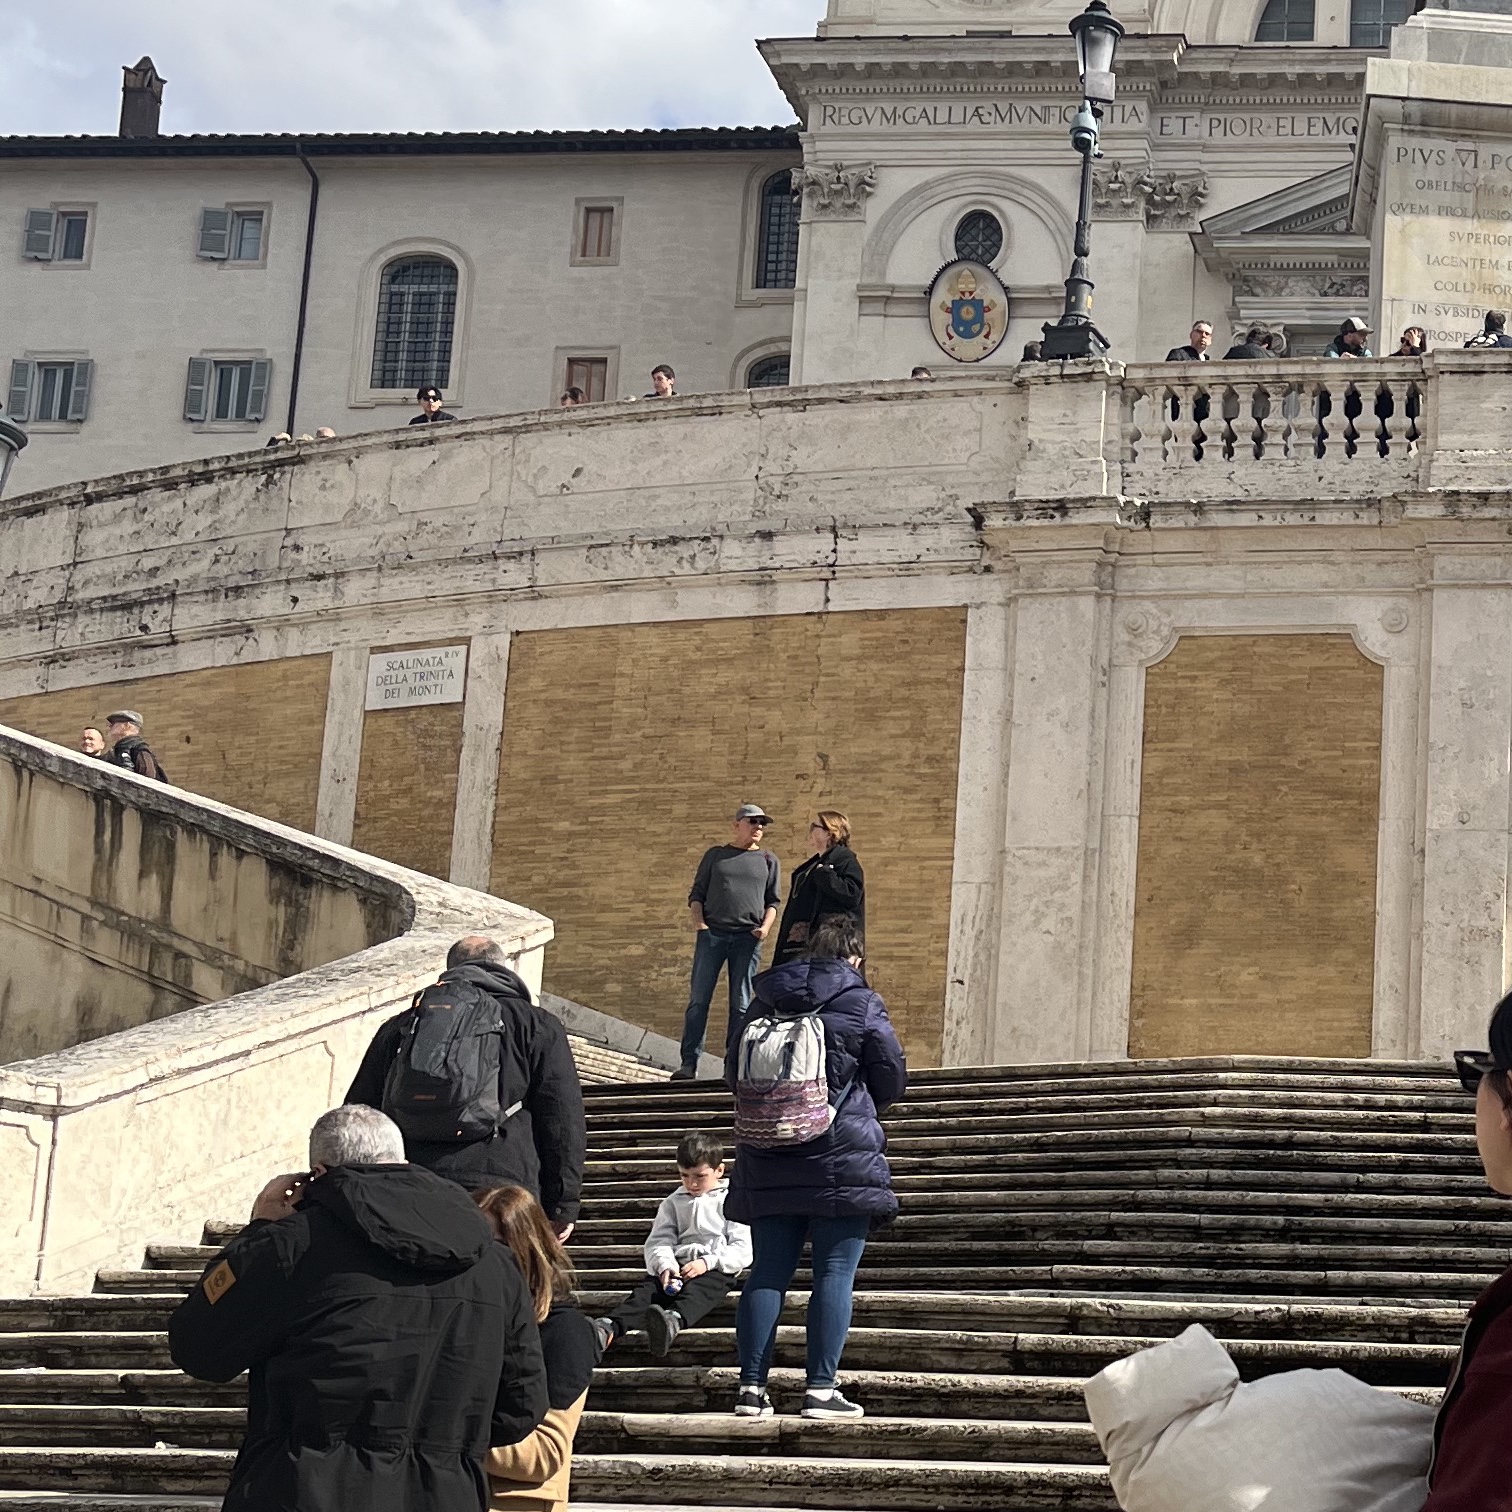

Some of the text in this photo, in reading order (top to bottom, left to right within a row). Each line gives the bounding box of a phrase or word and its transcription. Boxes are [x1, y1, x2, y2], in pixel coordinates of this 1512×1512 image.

[822, 104, 898, 126] REGVM
[992, 103, 1141, 126] MVNIFICTIA
[1159, 115, 1194, 136] ET
[1396, 146, 1446, 166] PIVS
[1389, 201, 1430, 216] QVEM
[1426, 253, 1499, 271] IACENTEM
[1412, 303, 1427, 315] IN
[386, 656, 444, 672] SCALINATA
[376, 673, 408, 687] DELLA
[384, 683, 443, 699] DEI MONTI
